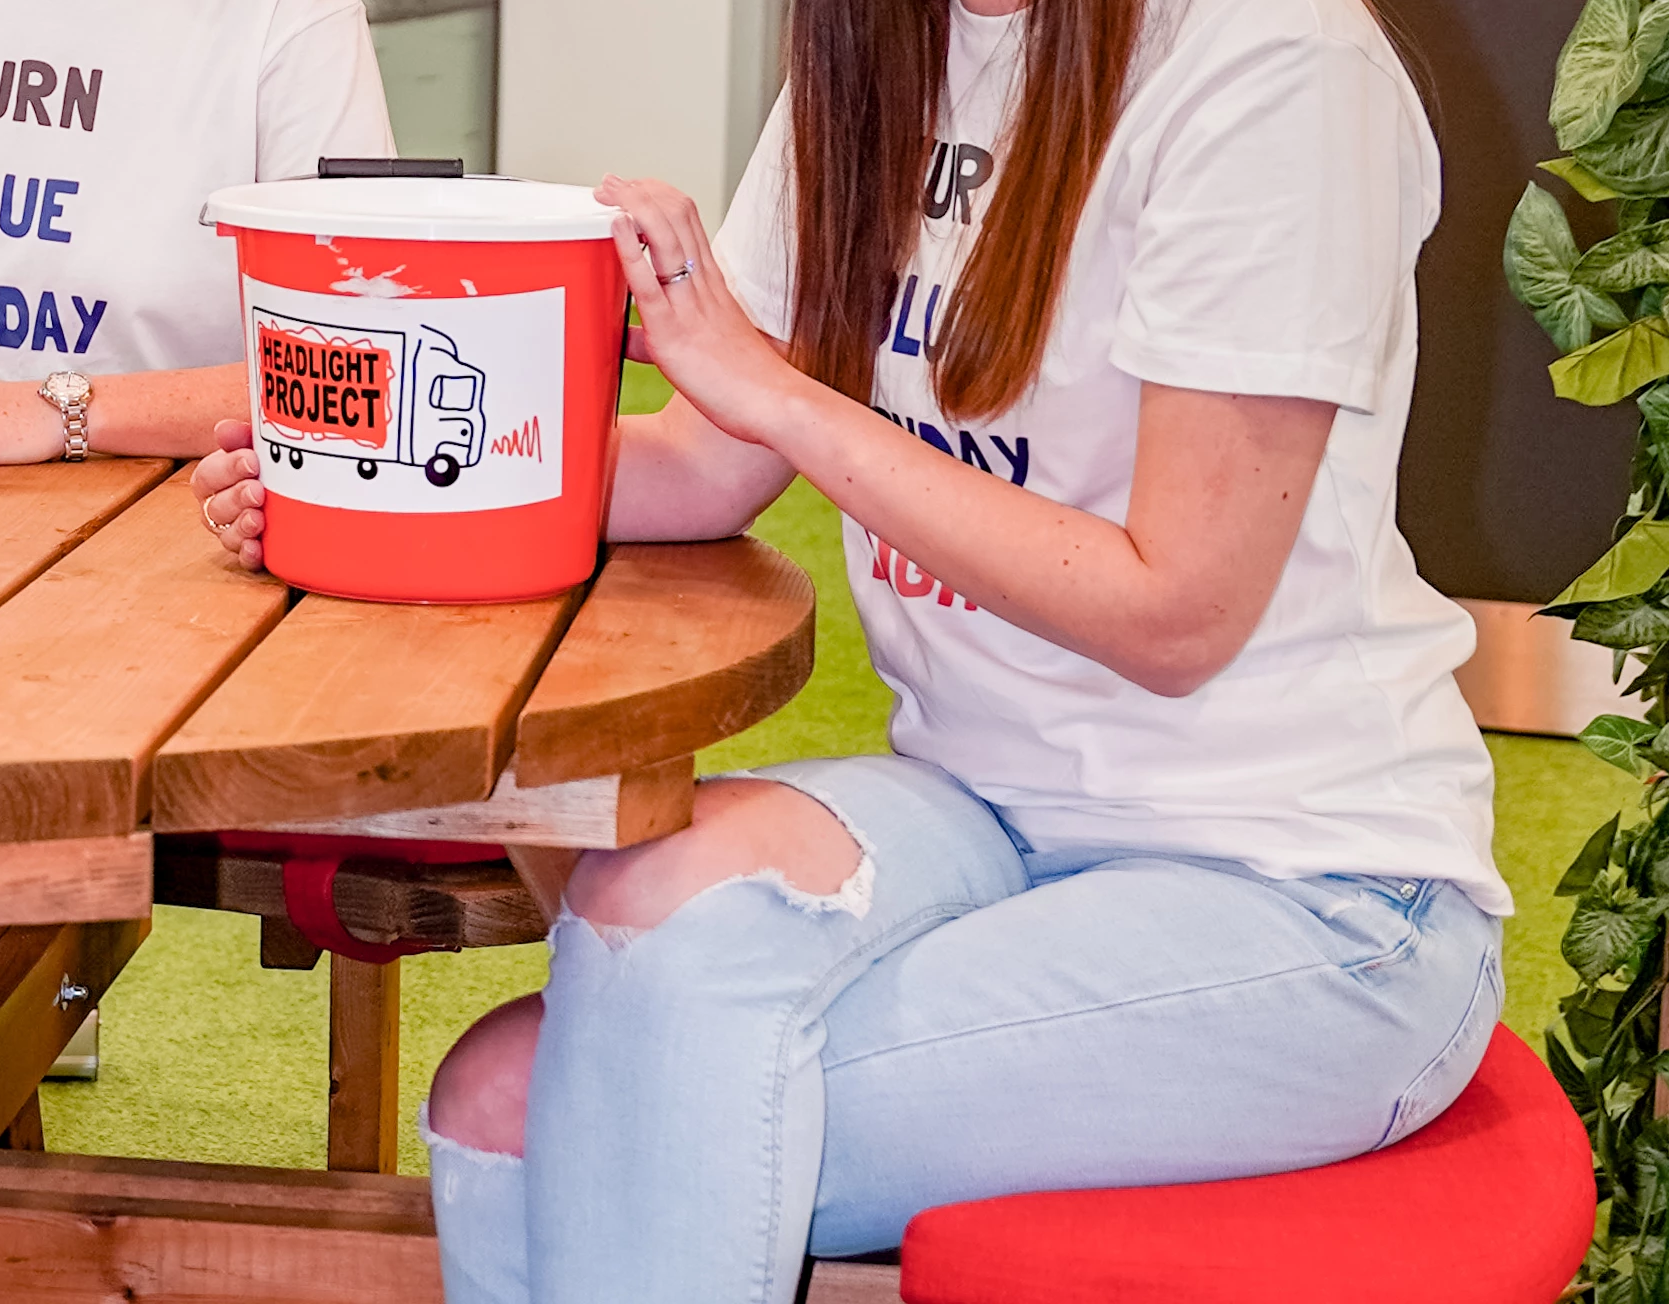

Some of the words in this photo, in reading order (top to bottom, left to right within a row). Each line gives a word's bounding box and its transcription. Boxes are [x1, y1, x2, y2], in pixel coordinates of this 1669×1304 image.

[922, 138, 995, 226] UR
[263, 336, 379, 384] HEADLIGHT
[264, 371, 381, 429] PROJECT
